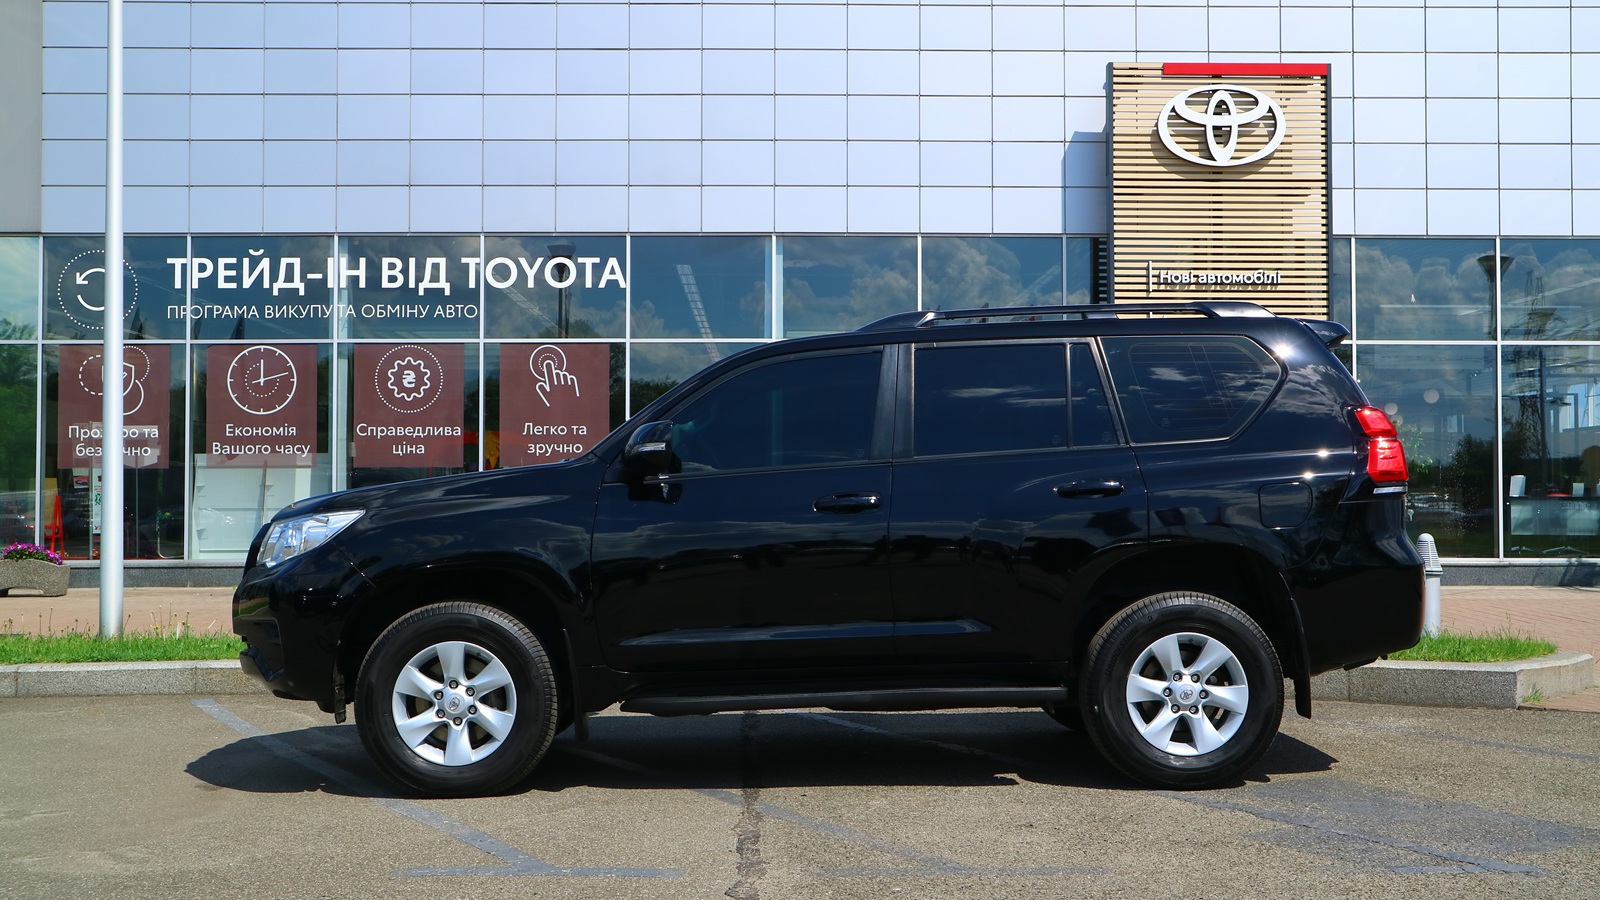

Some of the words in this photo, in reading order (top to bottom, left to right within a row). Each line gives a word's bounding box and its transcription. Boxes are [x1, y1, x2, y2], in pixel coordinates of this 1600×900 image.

[166, 248, 366, 296] ТРЕЙД-ІН
[381, 256, 451, 296] ВІД
[461, 256, 627, 290] TOYOTA
[1160, 270, 1194, 284] Нові
[1198, 269, 1281, 284] автомобілі
[167, 304, 260, 320] ПРОГРАМА
[264, 304, 333, 319] ВИКУПУ
[337, 304, 357, 318] ТА
[361, 304, 429, 319] ОБМІНУ
[433, 304, 478, 319] АВТО
[68, 425, 139, 442] Проо
[143, 428, 159, 438] та
[225, 423, 297, 437] Економія
[356, 423, 461, 439] Справедлива
[522, 422, 568, 436] Легко
[571, 425, 587, 436] та
[75, 443, 151, 457] безчно
[212, 442, 271, 455] Вашого
[275, 444, 311, 458] часу
[392, 441, 425, 457] ціна
[527, 443, 583, 457] зручно
